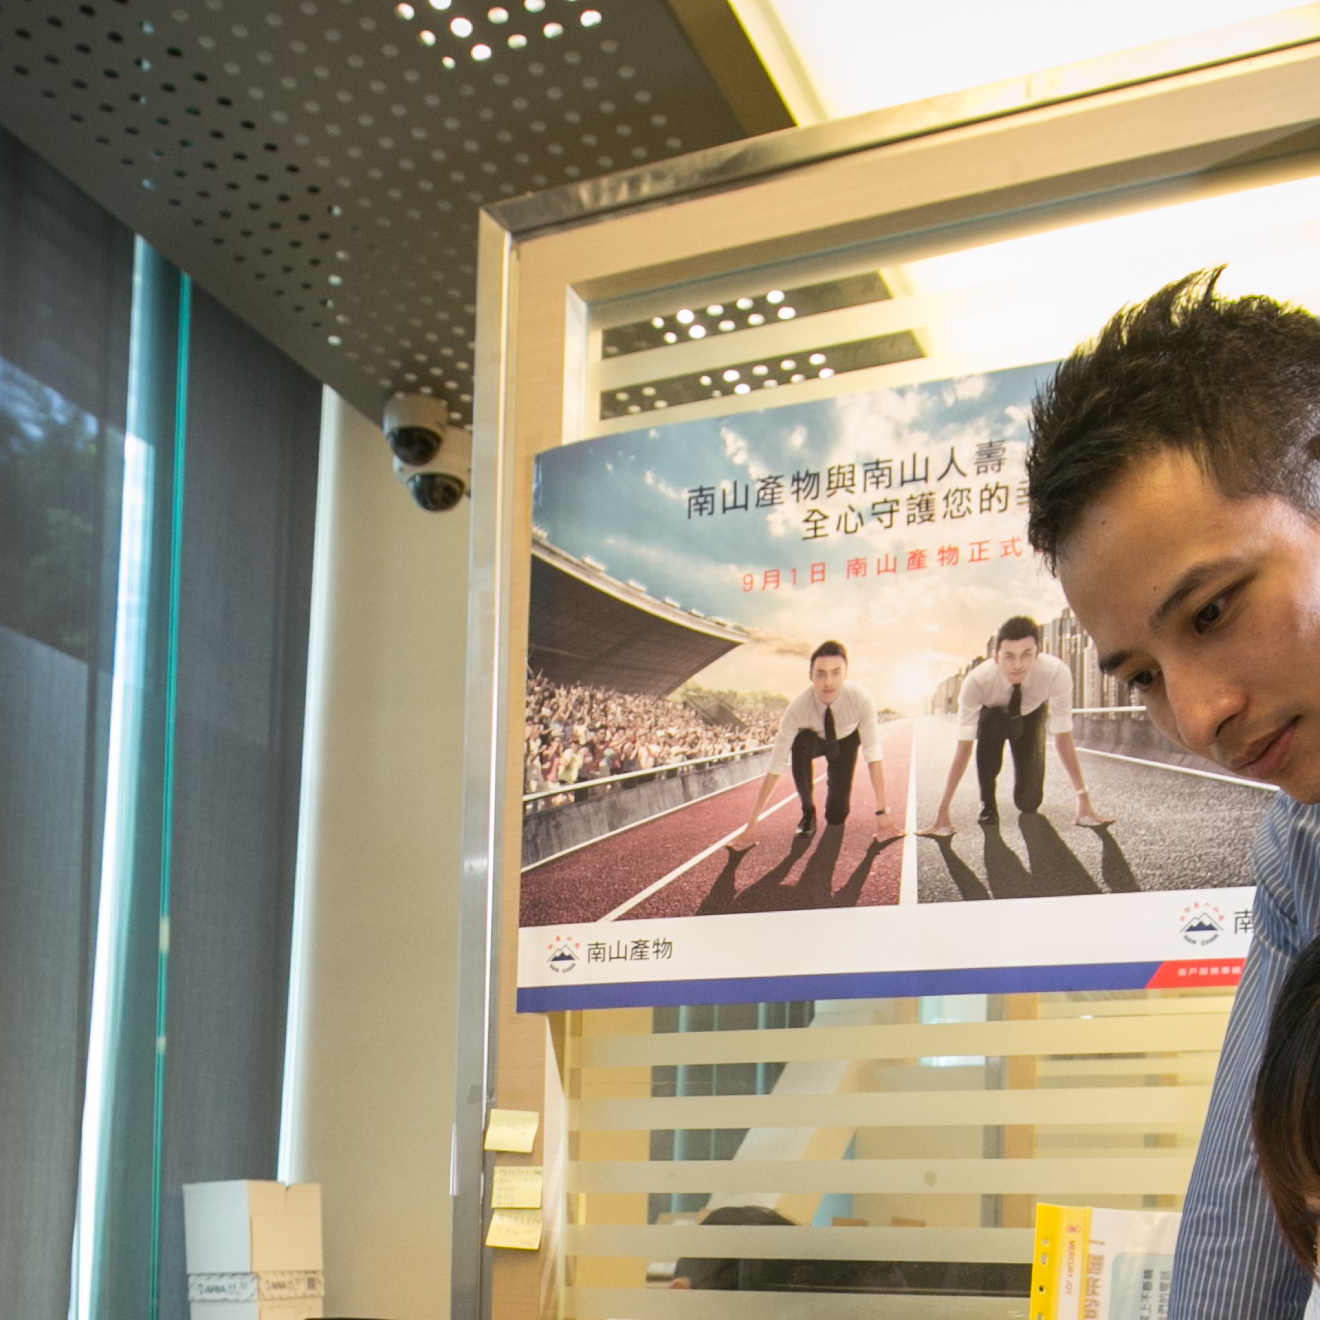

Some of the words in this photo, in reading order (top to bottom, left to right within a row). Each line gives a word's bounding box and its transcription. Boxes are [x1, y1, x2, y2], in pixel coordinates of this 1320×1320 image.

[686, 439, 1008, 520] 南山產物與南山人壽
[741, 562, 826, 593] 9月1日
[587, 937, 673, 964] 南山產物
[1067, 1240, 1077, 1278] MERCURY
